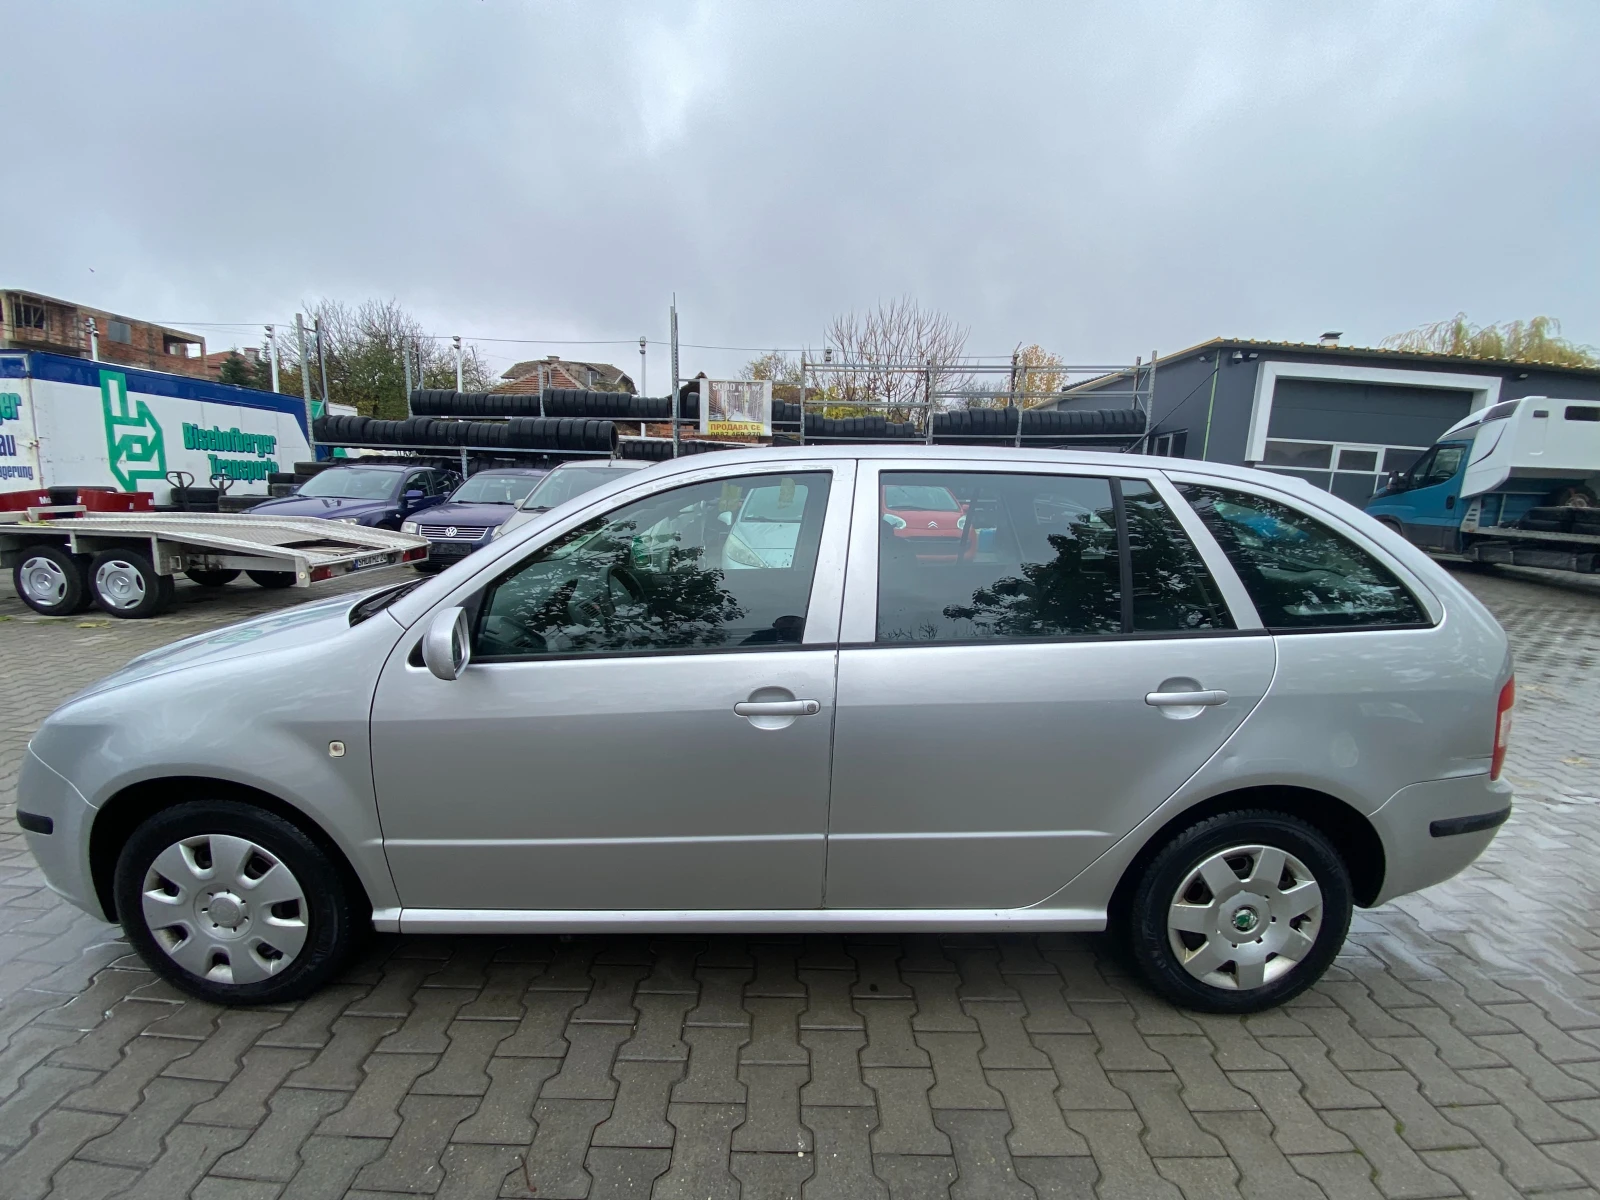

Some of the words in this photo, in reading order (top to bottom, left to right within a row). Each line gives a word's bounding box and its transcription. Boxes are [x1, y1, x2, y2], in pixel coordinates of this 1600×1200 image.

[710, 423, 749, 431] ПРОДАВА
[182, 422, 277, 458] Bischofberger
[0, 465, 33, 480] gerung
[207, 454, 280, 485] Transporte
